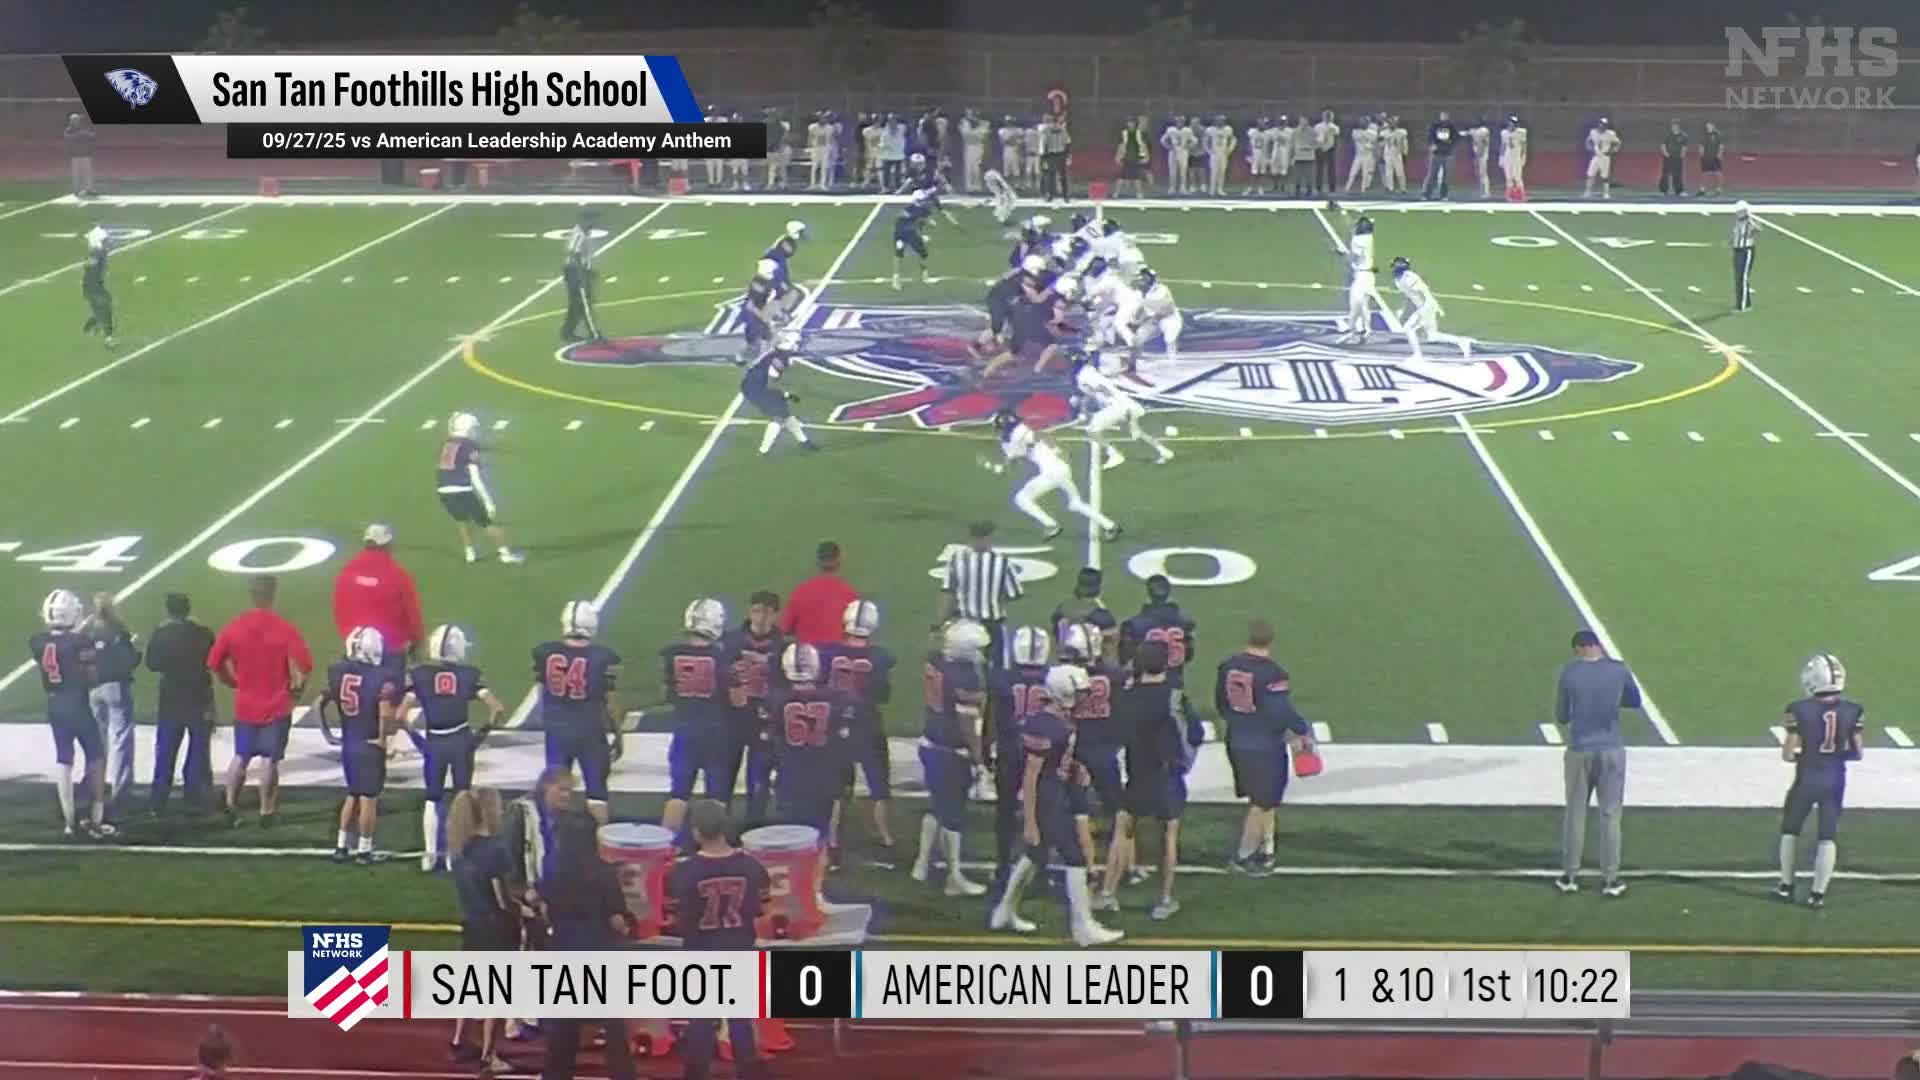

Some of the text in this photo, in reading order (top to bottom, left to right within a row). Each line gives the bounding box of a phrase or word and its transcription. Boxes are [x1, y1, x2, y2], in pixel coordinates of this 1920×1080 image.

[41, 642, 62, 683] 4
[544, 653, 588, 700] 64
[339, 674, 364, 717] 5
[1820, 710, 1837, 755] 1
[697, 875, 747, 931] 77
